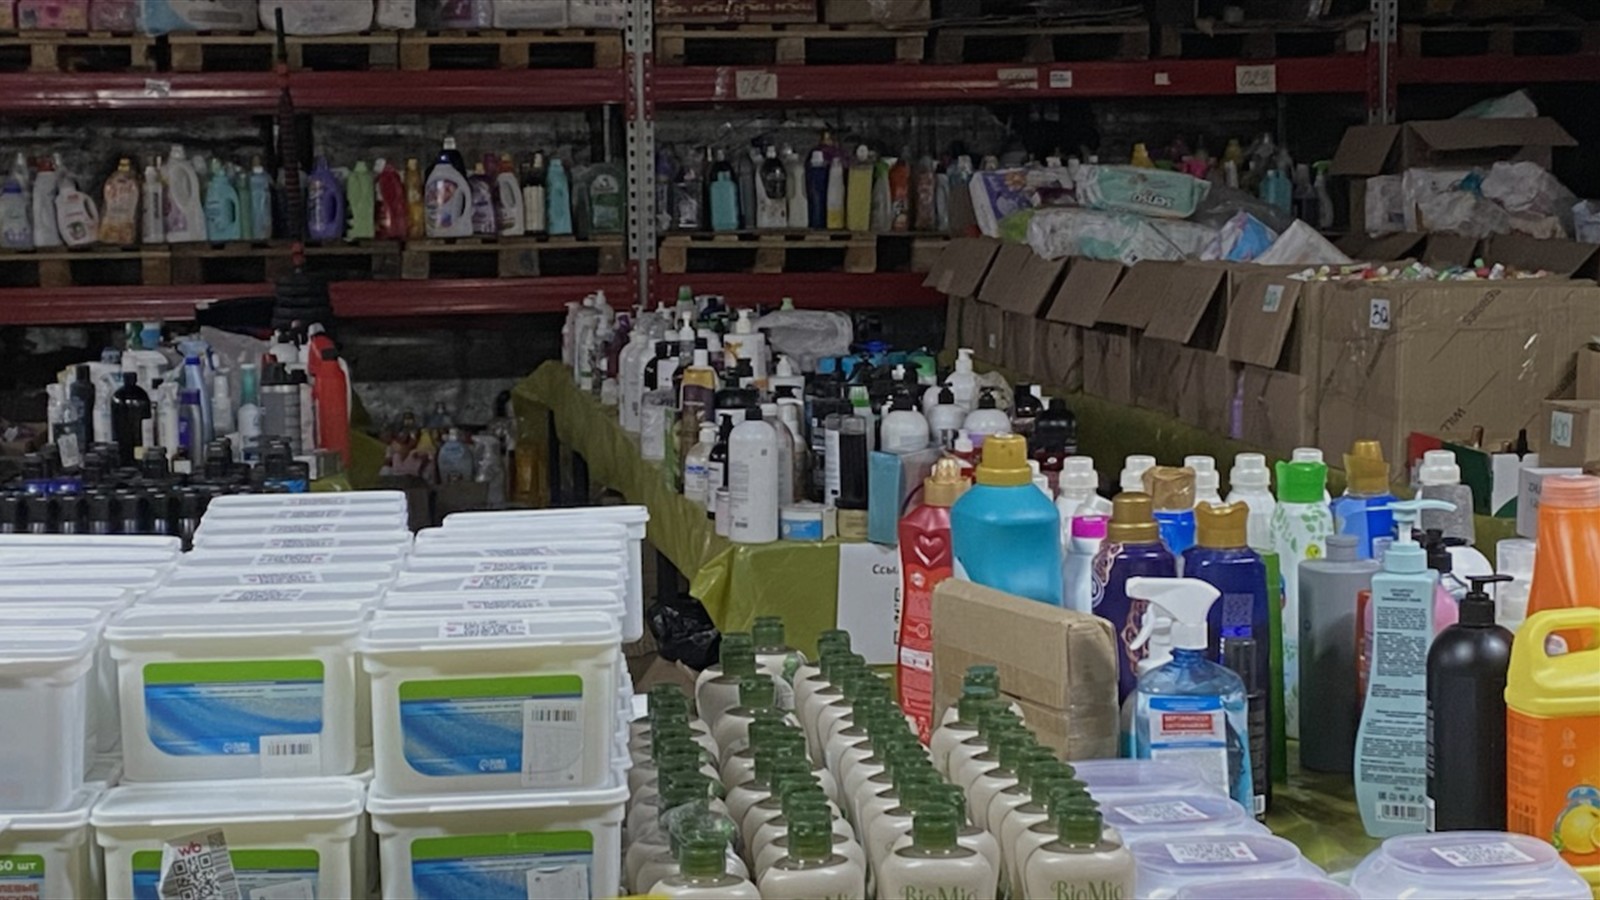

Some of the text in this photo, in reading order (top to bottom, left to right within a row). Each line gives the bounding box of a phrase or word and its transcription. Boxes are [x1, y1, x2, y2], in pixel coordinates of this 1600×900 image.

[872, 563, 900, 575] Ссы
[178, 841, 202, 857] wb
[17, 862, 37, 871] шт
[1050, 880, 1124, 900] BioMio
